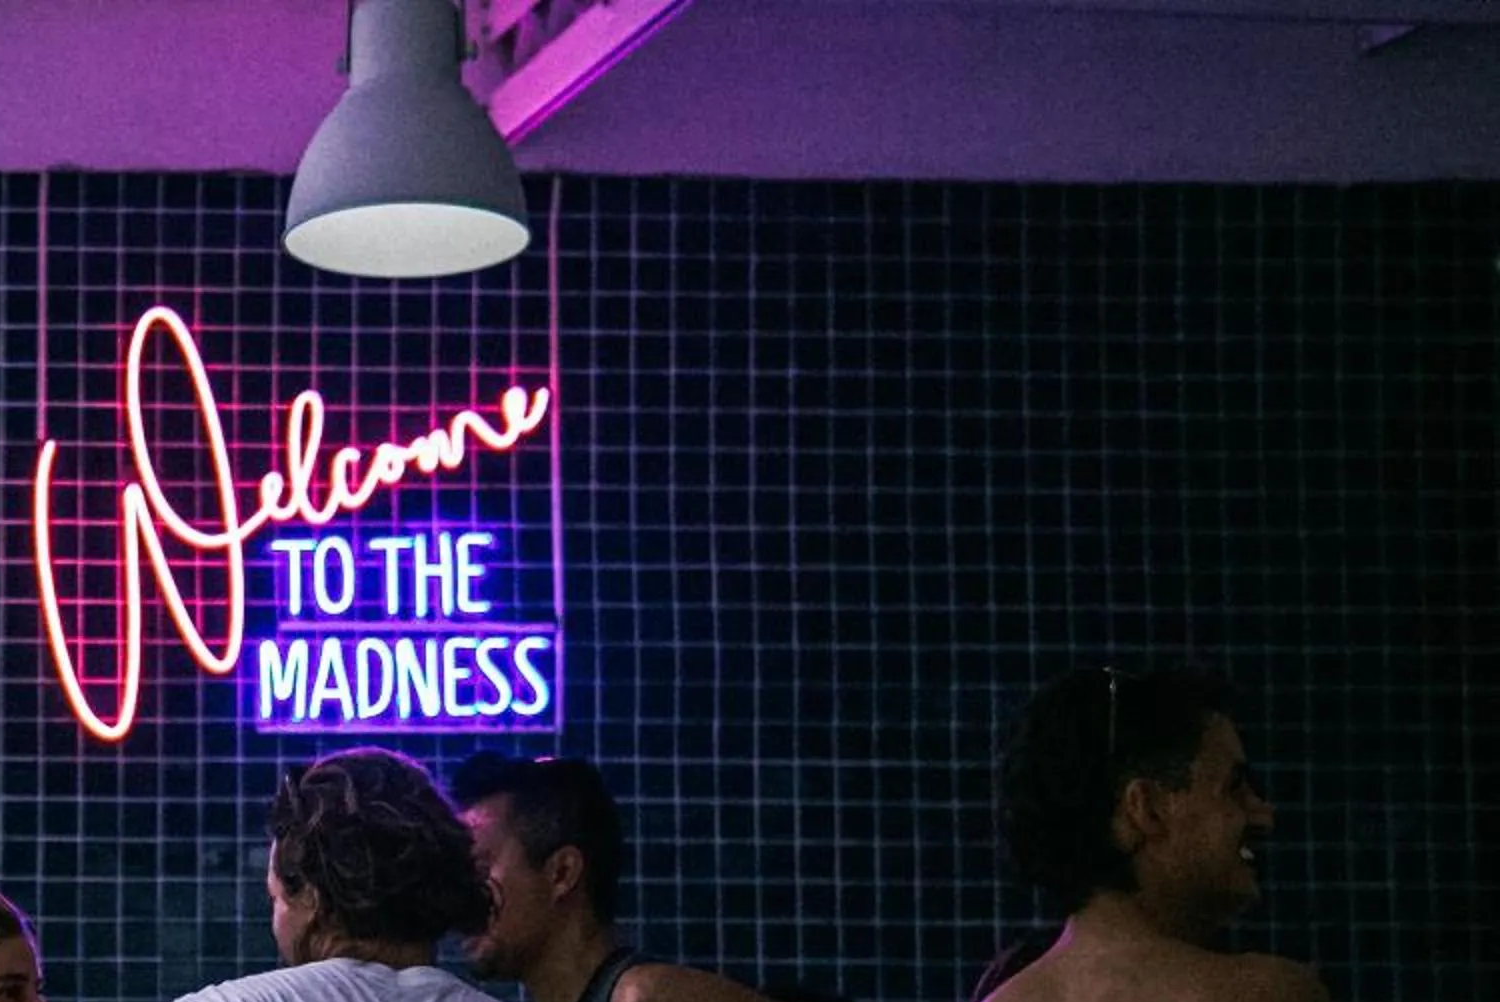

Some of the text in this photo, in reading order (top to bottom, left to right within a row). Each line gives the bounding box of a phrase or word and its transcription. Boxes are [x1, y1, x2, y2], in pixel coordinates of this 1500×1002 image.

[34, 305, 550, 741] Welcome
[271, 532, 494, 617] TO THE
[259, 637, 550, 720] MADNESS
